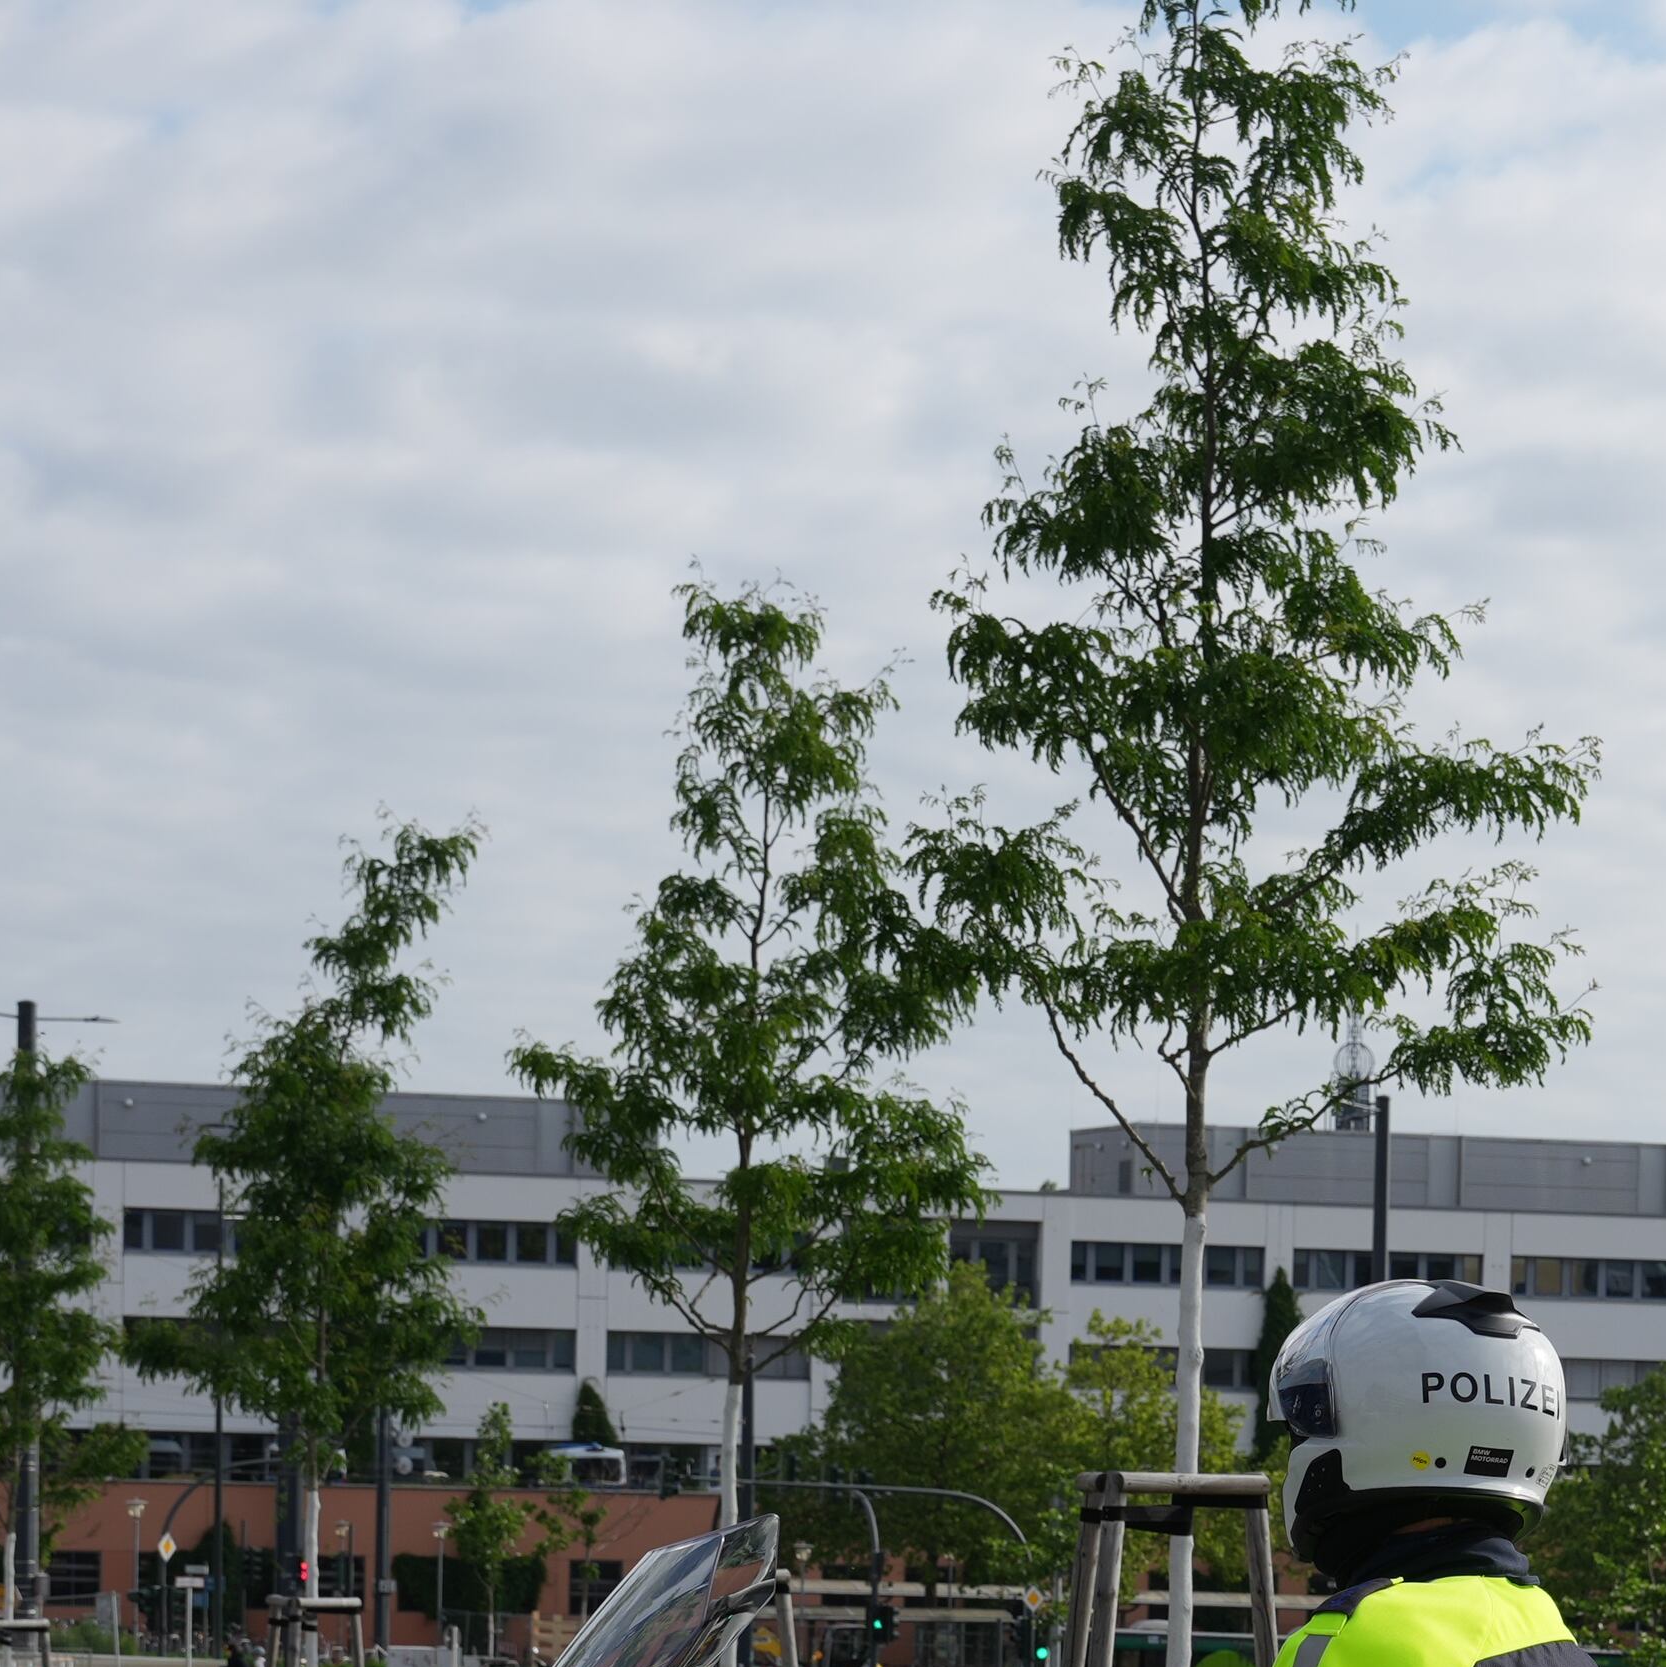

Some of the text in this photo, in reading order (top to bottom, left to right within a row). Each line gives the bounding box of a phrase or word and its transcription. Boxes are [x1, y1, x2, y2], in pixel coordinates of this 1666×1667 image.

[1421, 1371, 1560, 1420] POLIZEI
[1472, 1448, 1490, 1456] BMW
[1470, 1454, 1509, 1465] MOTORRAD
